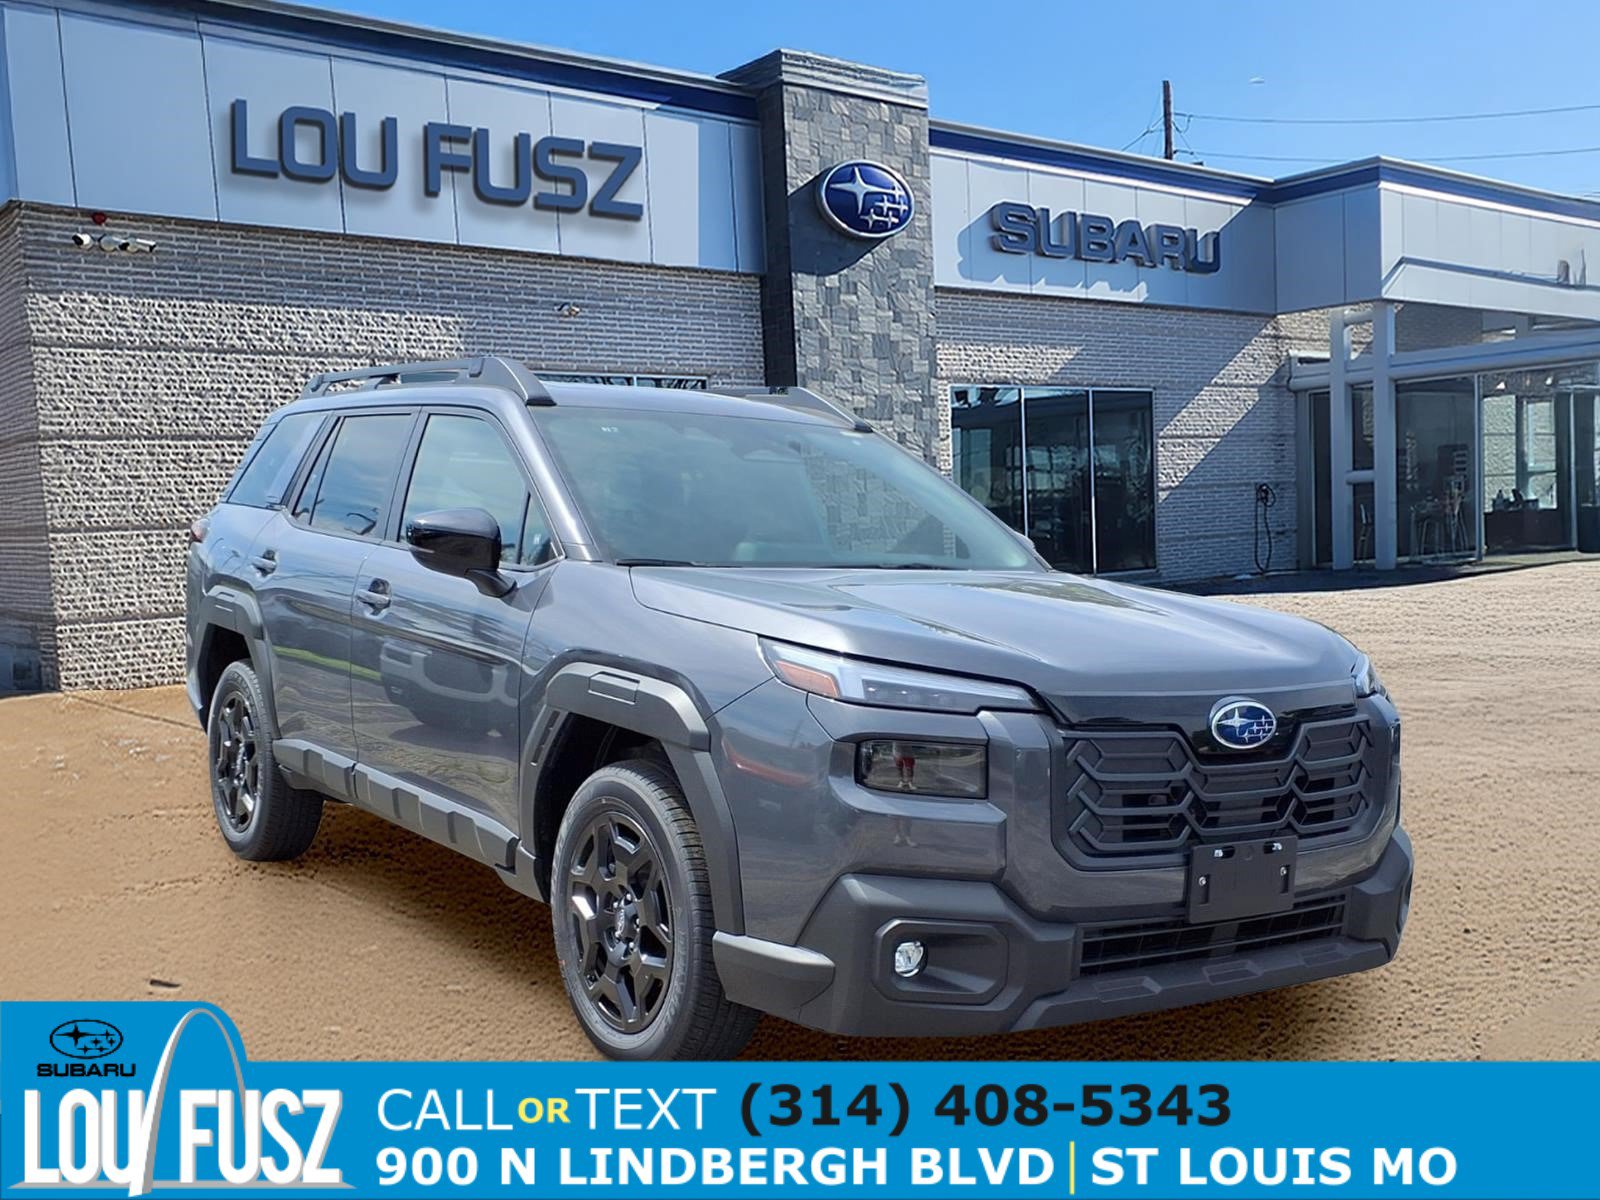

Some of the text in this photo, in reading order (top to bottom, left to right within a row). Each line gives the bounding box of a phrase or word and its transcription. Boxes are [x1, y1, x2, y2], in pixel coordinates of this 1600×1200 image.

[231, 99, 644, 219] LOU FUSZ
[991, 202, 1221, 274] SUBARU
